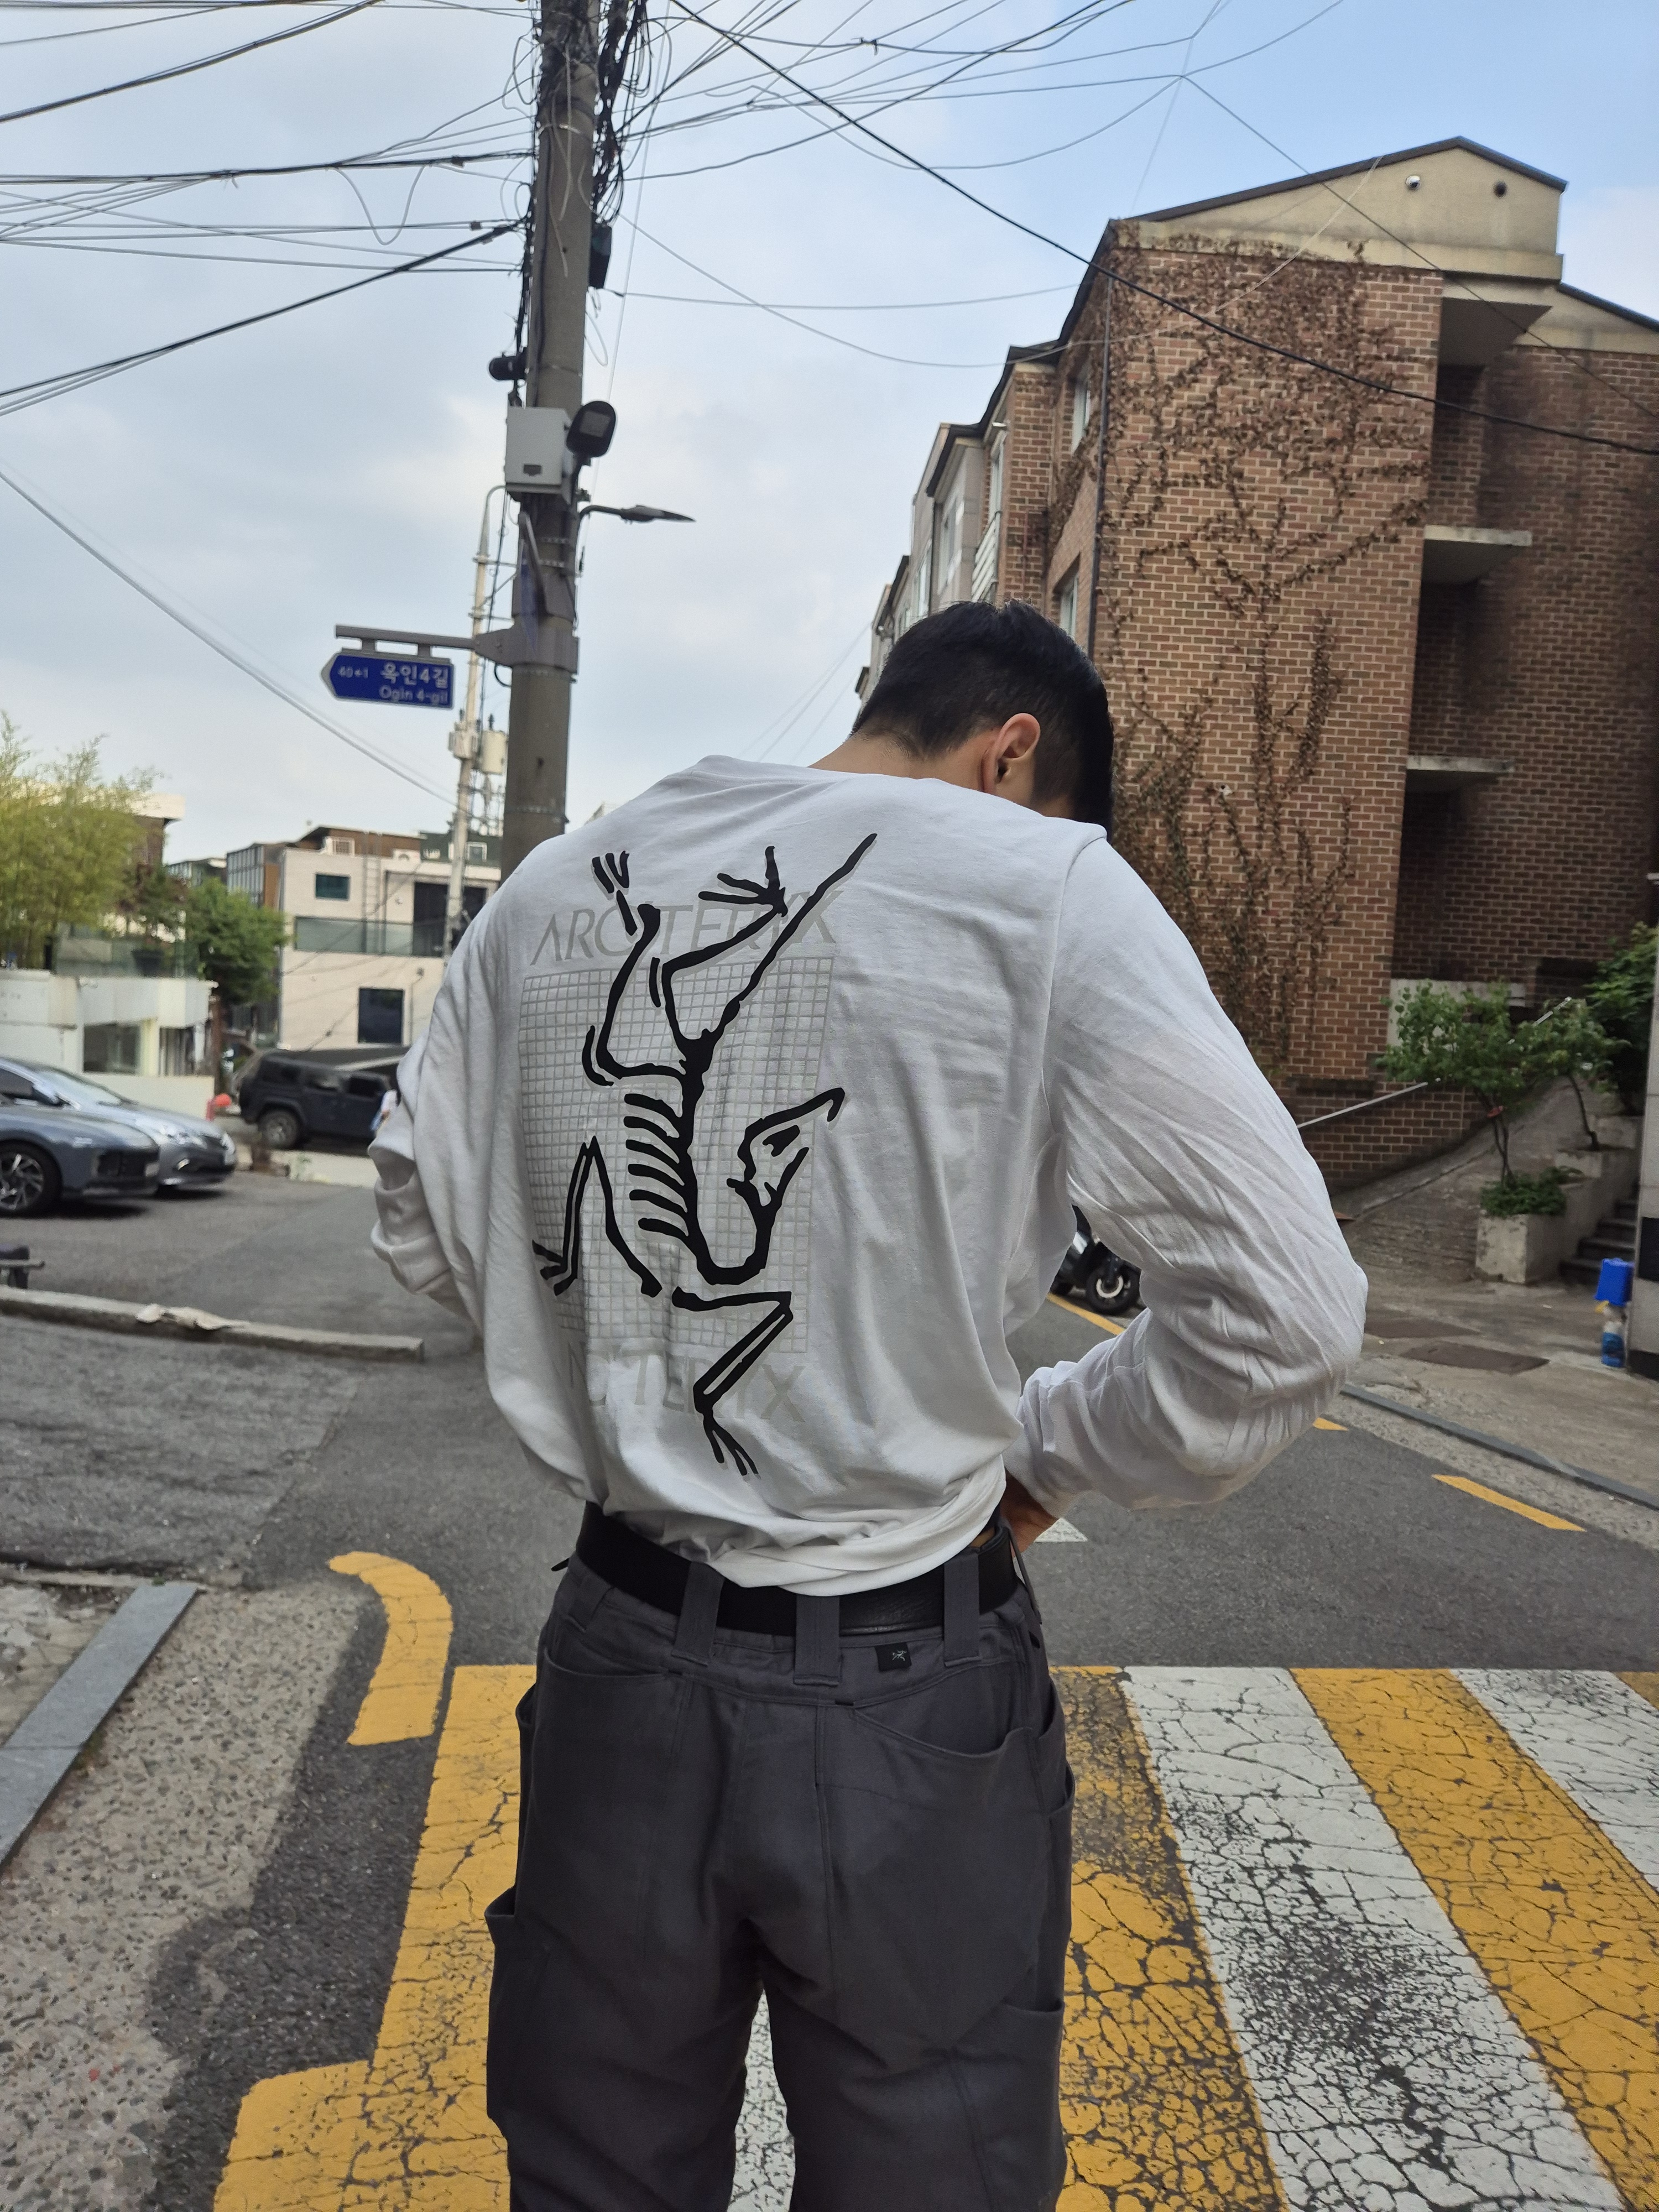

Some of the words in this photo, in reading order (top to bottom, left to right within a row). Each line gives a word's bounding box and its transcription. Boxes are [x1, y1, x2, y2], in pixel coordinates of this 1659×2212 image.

[380, 662, 448, 688] 옥인4길
[379, 685, 414, 702] Ogin
[416, 688, 448, 706] 4-gil
[529, 890, 844, 966] ARCTERX
